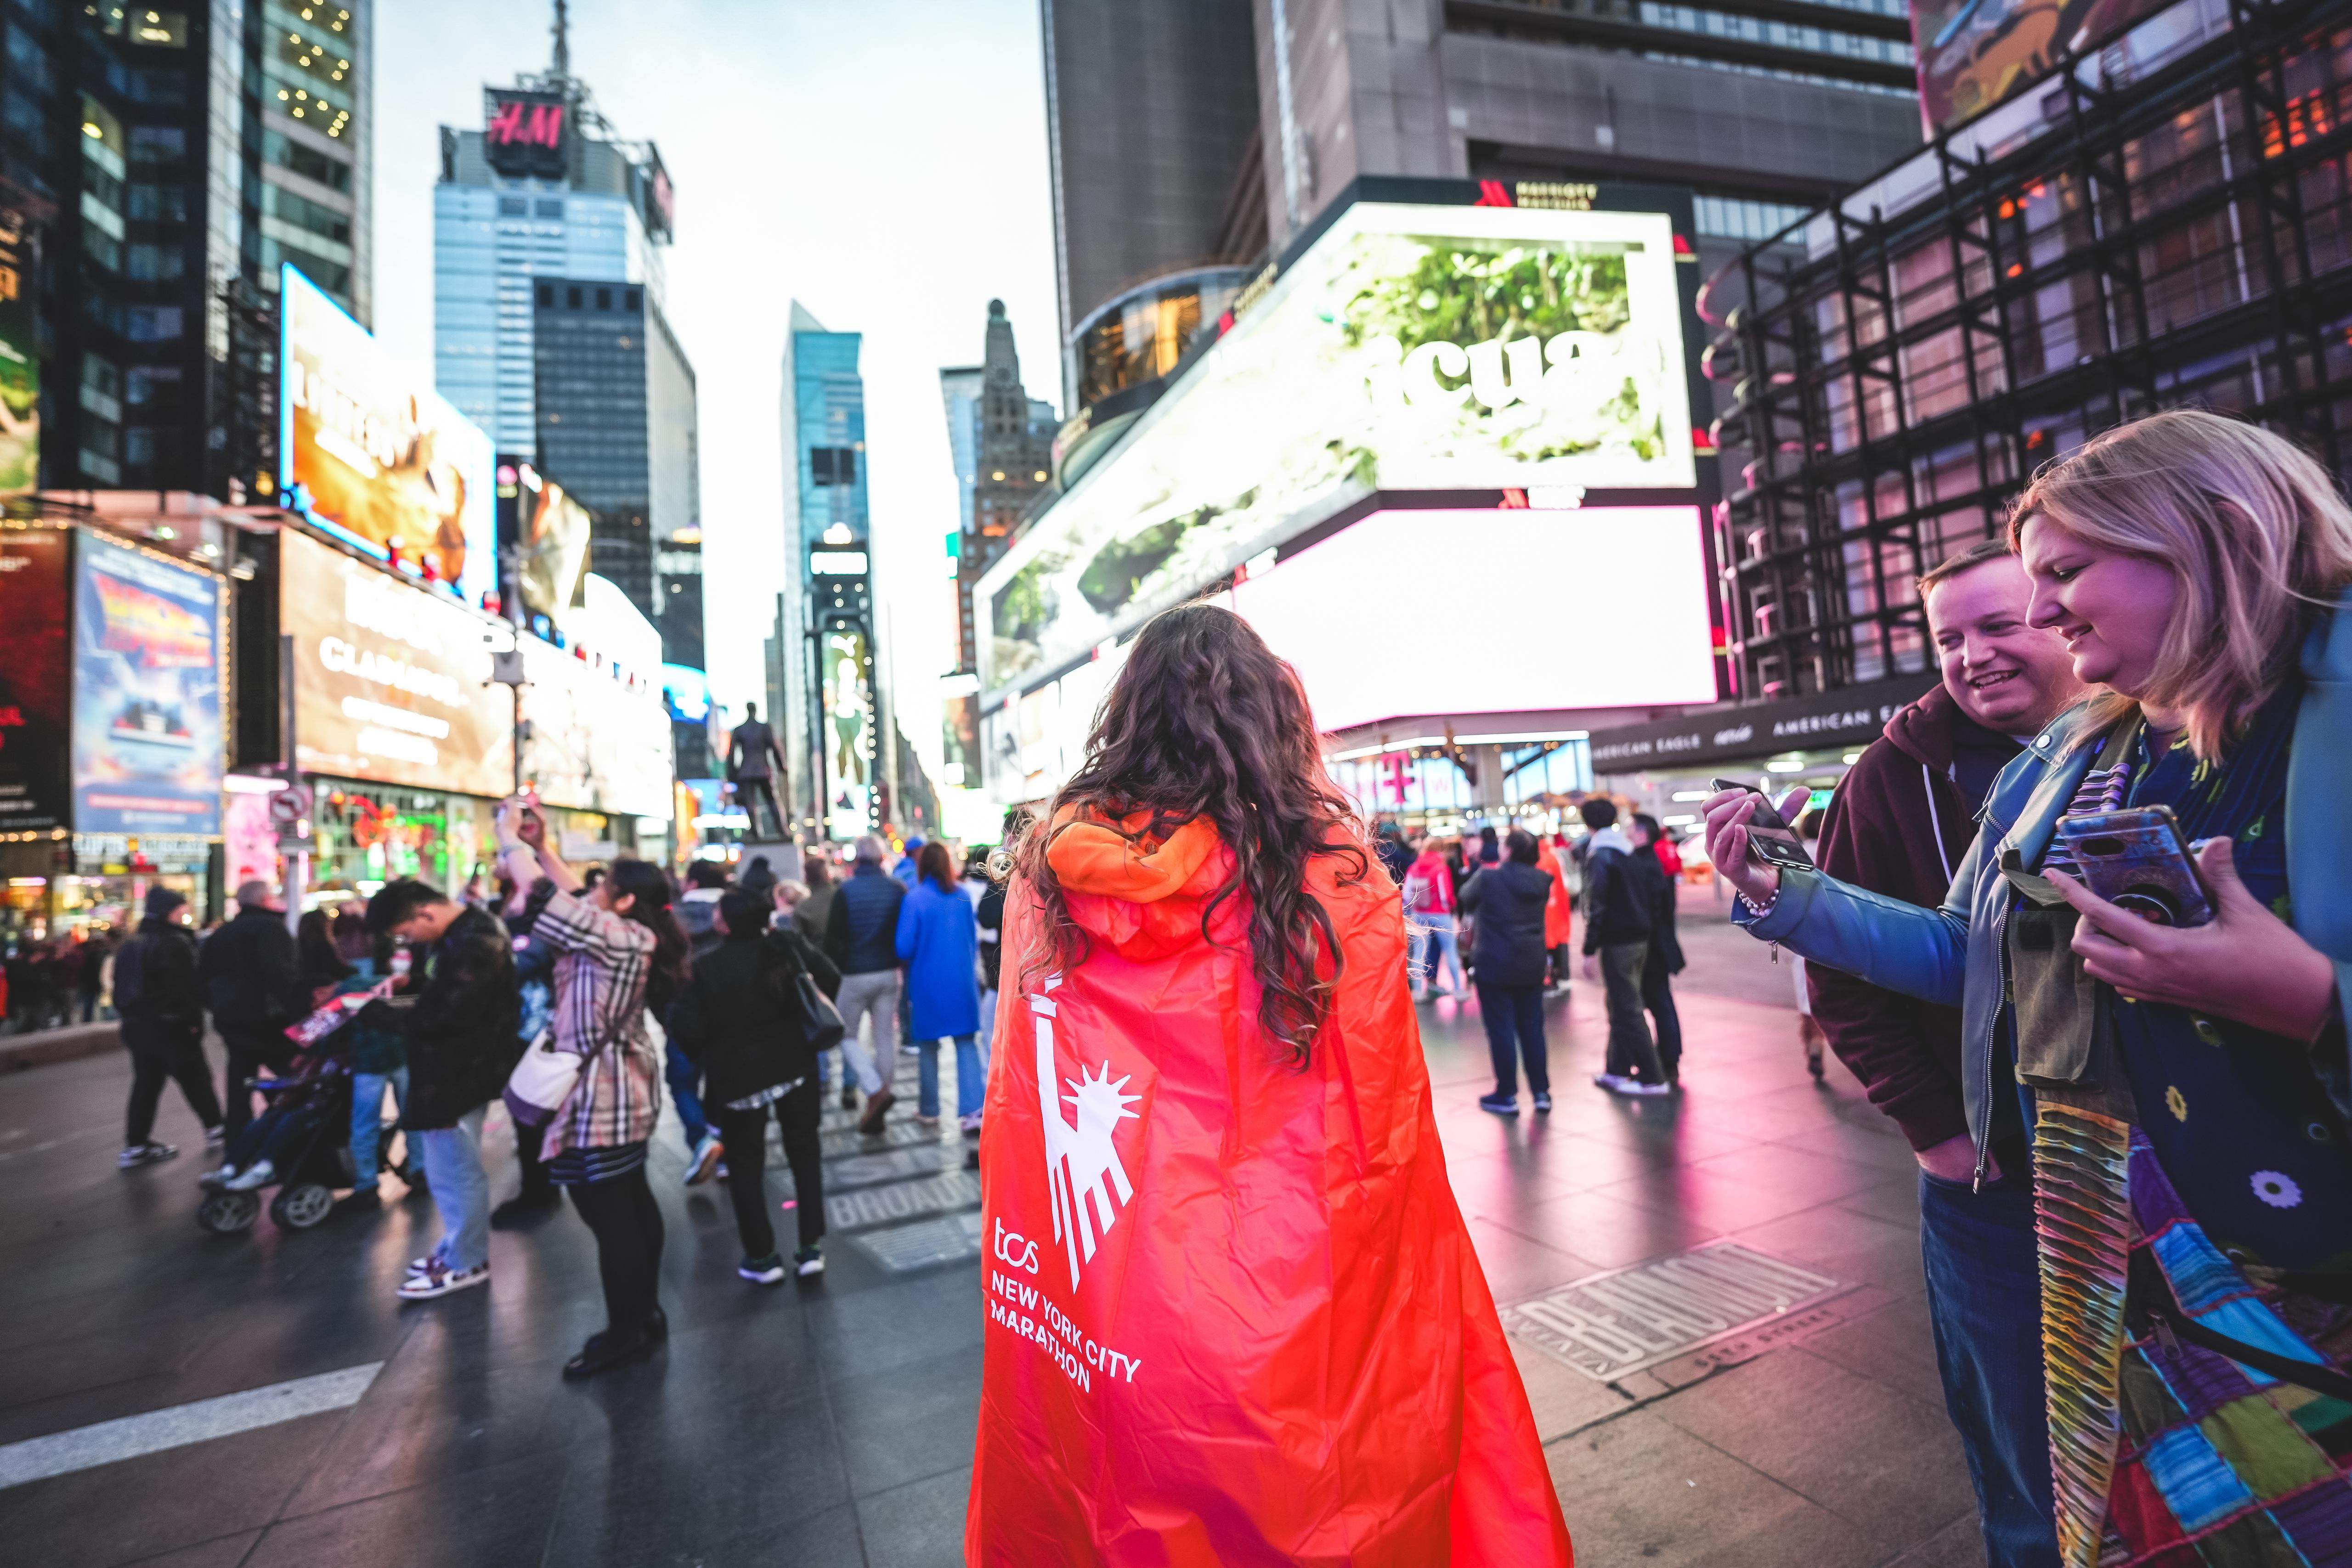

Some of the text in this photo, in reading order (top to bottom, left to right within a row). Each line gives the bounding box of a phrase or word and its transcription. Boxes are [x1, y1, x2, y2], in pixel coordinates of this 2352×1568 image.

[1591, 741, 1653, 761] MERICAN
[1772, 708, 1871, 737] AMERICAN
[994, 1216, 1039, 1275] tcs
[990, 1298, 1090, 1394] MARATHON
[991, 1269, 1142, 1383] NEW YORK CITY
